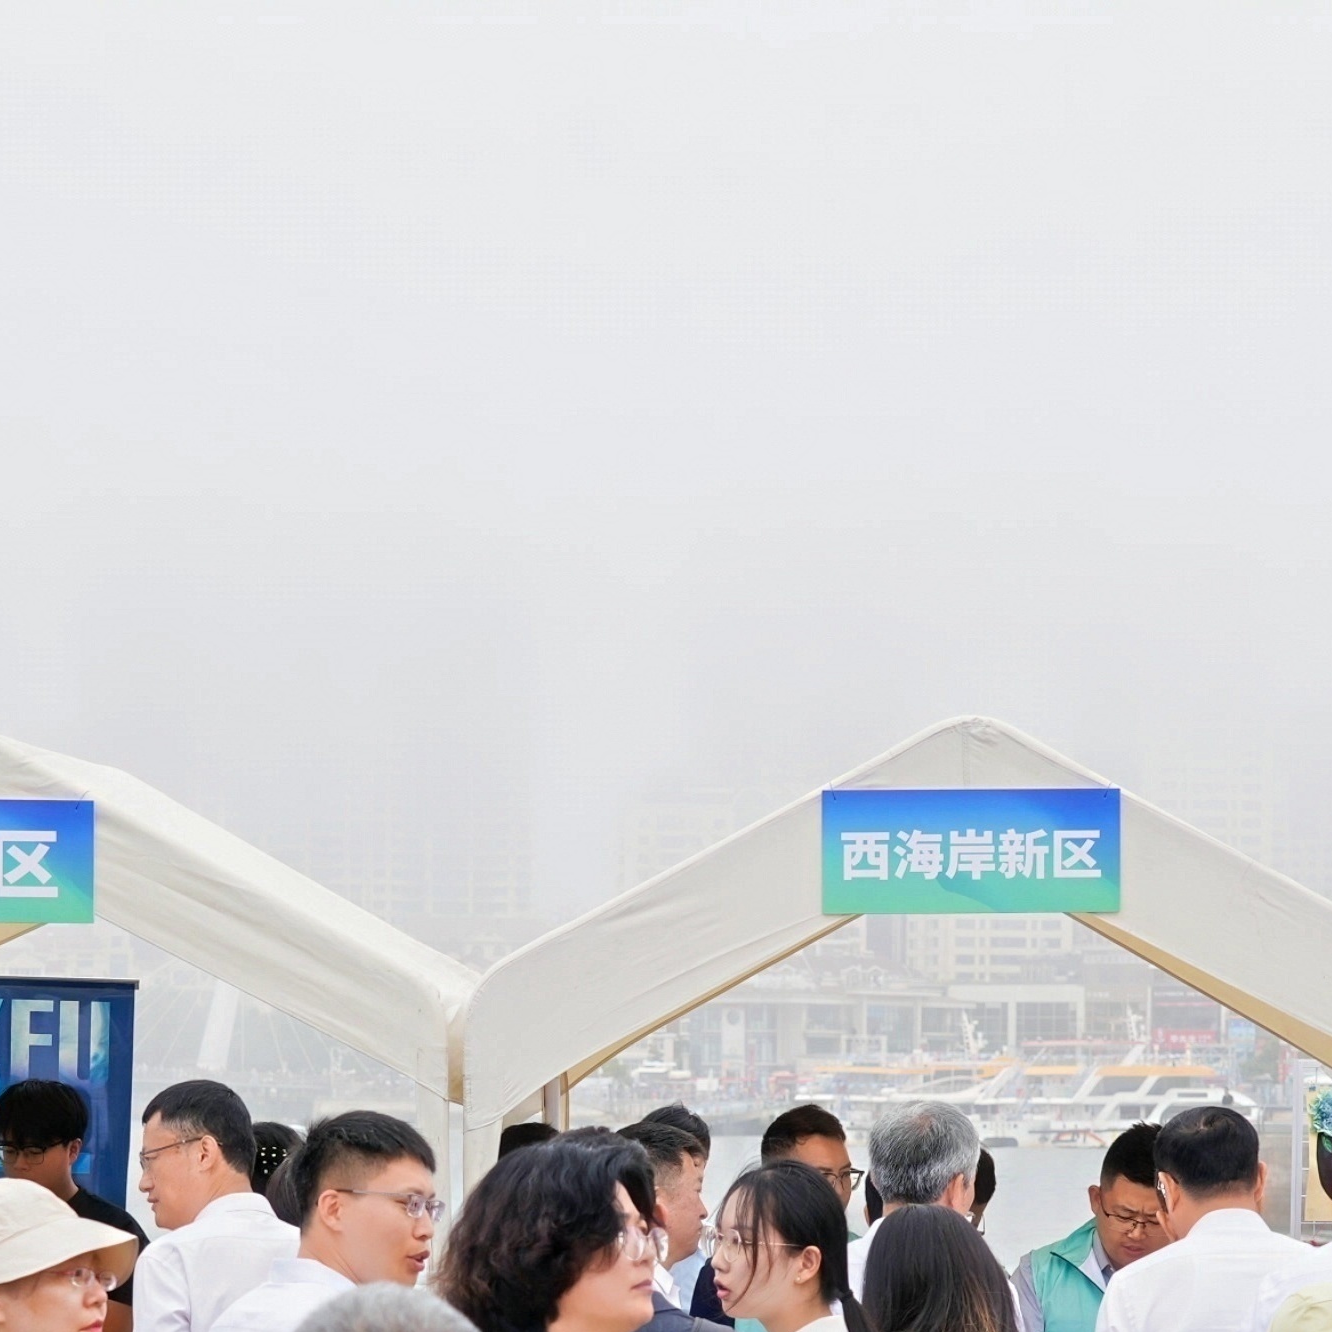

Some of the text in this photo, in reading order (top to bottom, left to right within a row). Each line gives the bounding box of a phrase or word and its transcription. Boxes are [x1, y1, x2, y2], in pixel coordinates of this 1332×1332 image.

[840, 828, 1102, 881] 西海岸新区
